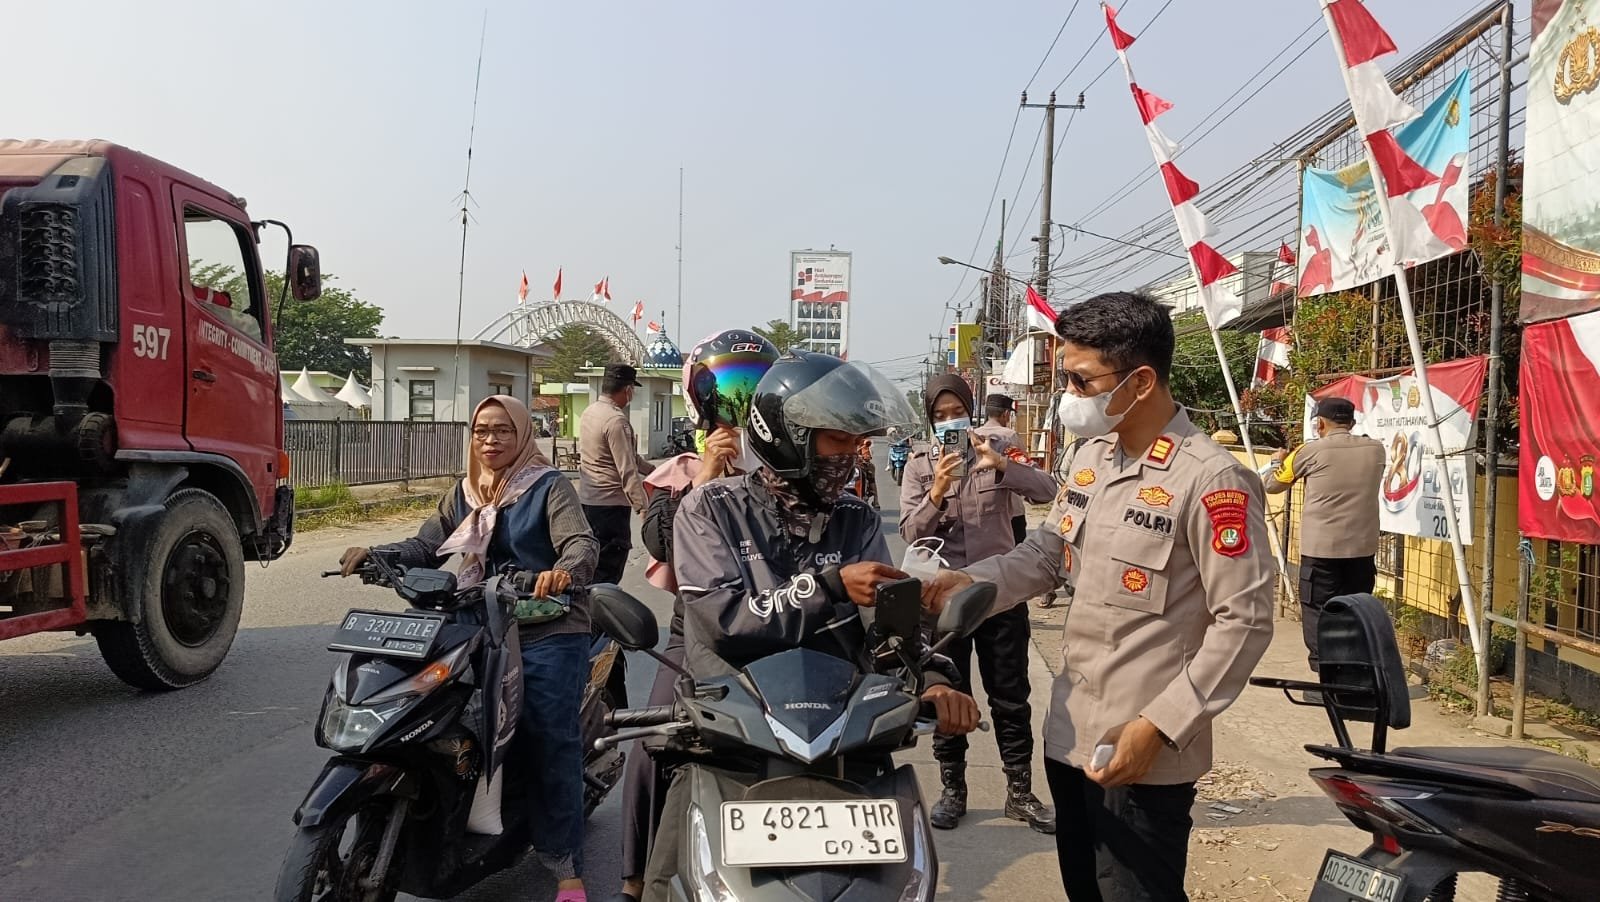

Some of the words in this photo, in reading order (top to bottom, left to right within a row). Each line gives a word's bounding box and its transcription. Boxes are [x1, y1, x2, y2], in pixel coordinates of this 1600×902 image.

[133, 324, 171, 361] 597
[199, 319, 228, 347] INTEGRITY
[731, 343, 763, 353] GM
[1123, 508, 1173, 534] POLRI
[345, 617, 357, 630] B
[364, 619, 402, 635] 3201
[404, 622, 434, 637] CLE
[784, 702, 832, 710] HONDA
[400, 719, 435, 742] HONDA
[729, 808, 745, 831] B
[762, 806, 829, 829] 4821
[845, 804, 895, 828] THR
[1323, 860, 1340, 882] AD
[1338, 865, 1370, 893] 2276
